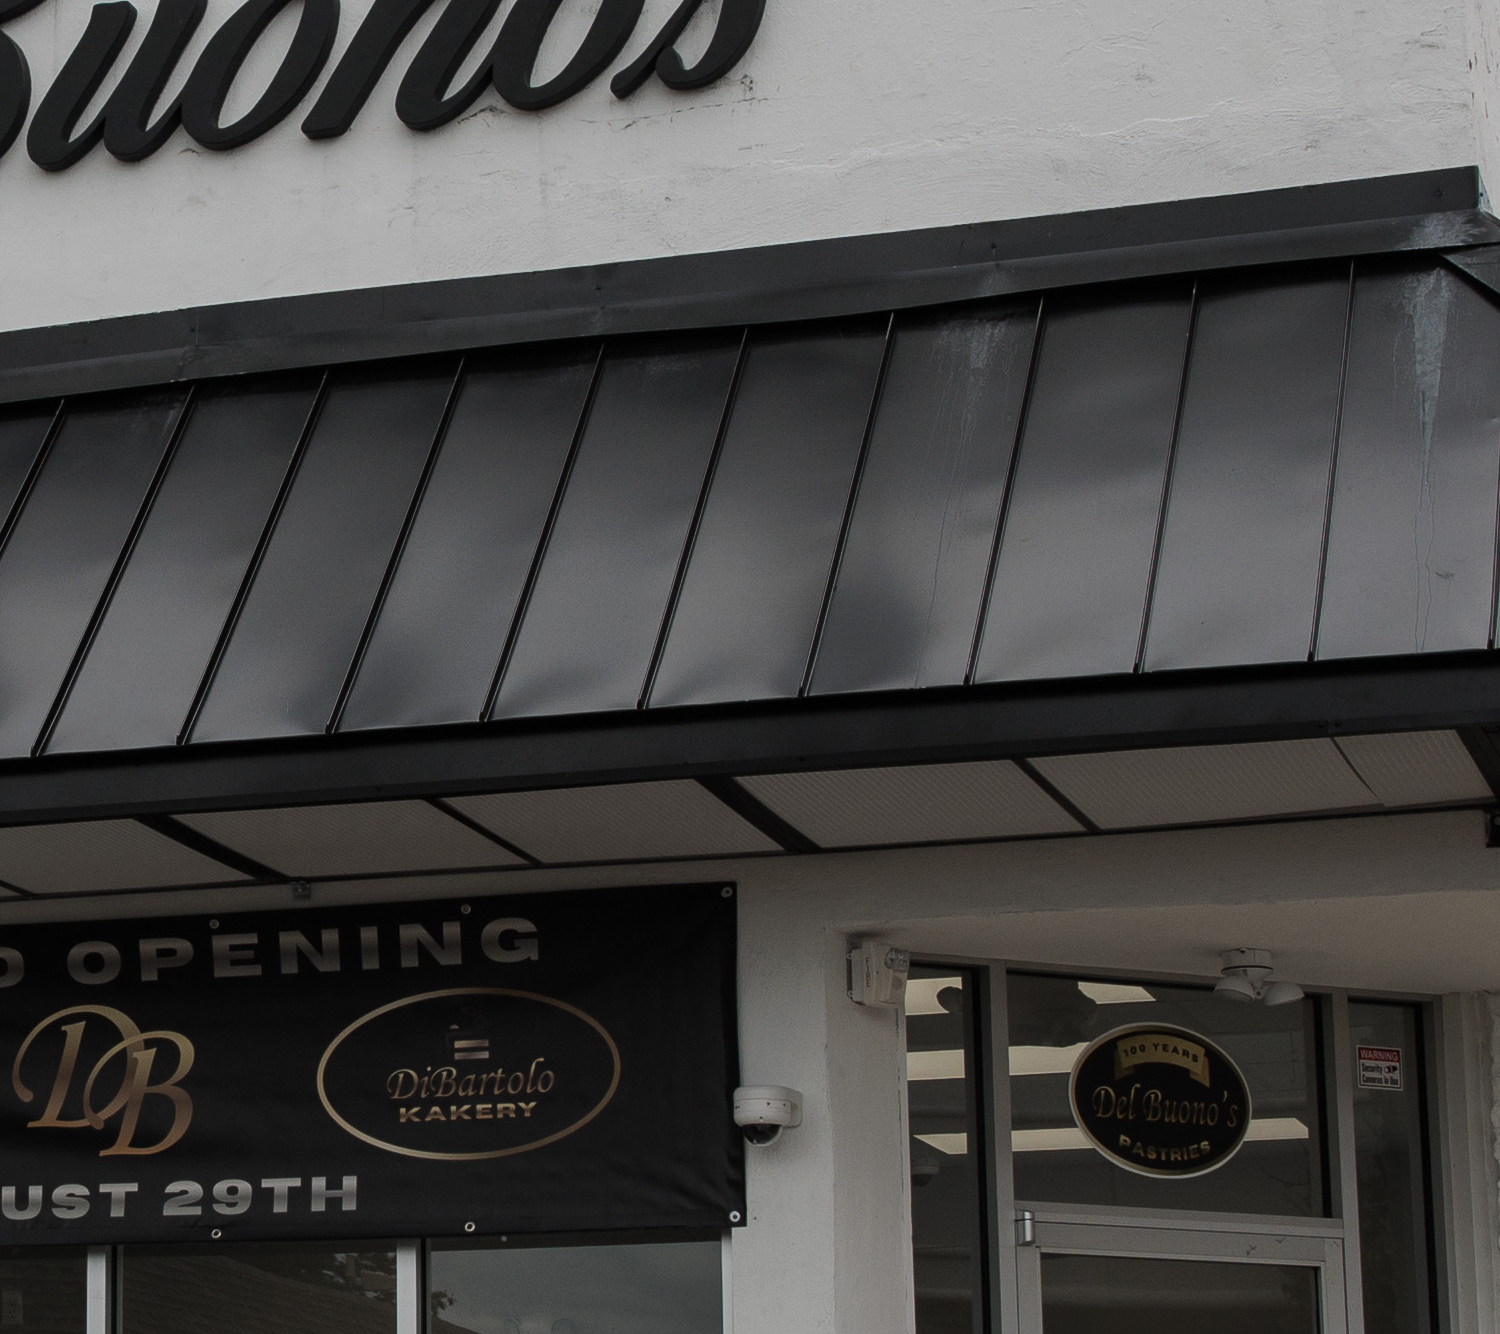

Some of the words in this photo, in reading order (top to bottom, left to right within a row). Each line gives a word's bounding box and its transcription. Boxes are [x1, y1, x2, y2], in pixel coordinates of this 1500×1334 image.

[66, 917, 543, 987] OPENING
[1124, 1044, 1146, 1058] 100
[1152, 1042, 1200, 1064] YEARS
[387, 1056, 557, 1107] DiBartolo
[397, 1098, 540, 1123] KAKERY
[1092, 1083, 1141, 1120] Del
[1142, 1090, 1239, 1128] Buono's
[1118, 1134, 1212, 1162] PASTRIES
[161, 1175, 361, 1220] 29TH
